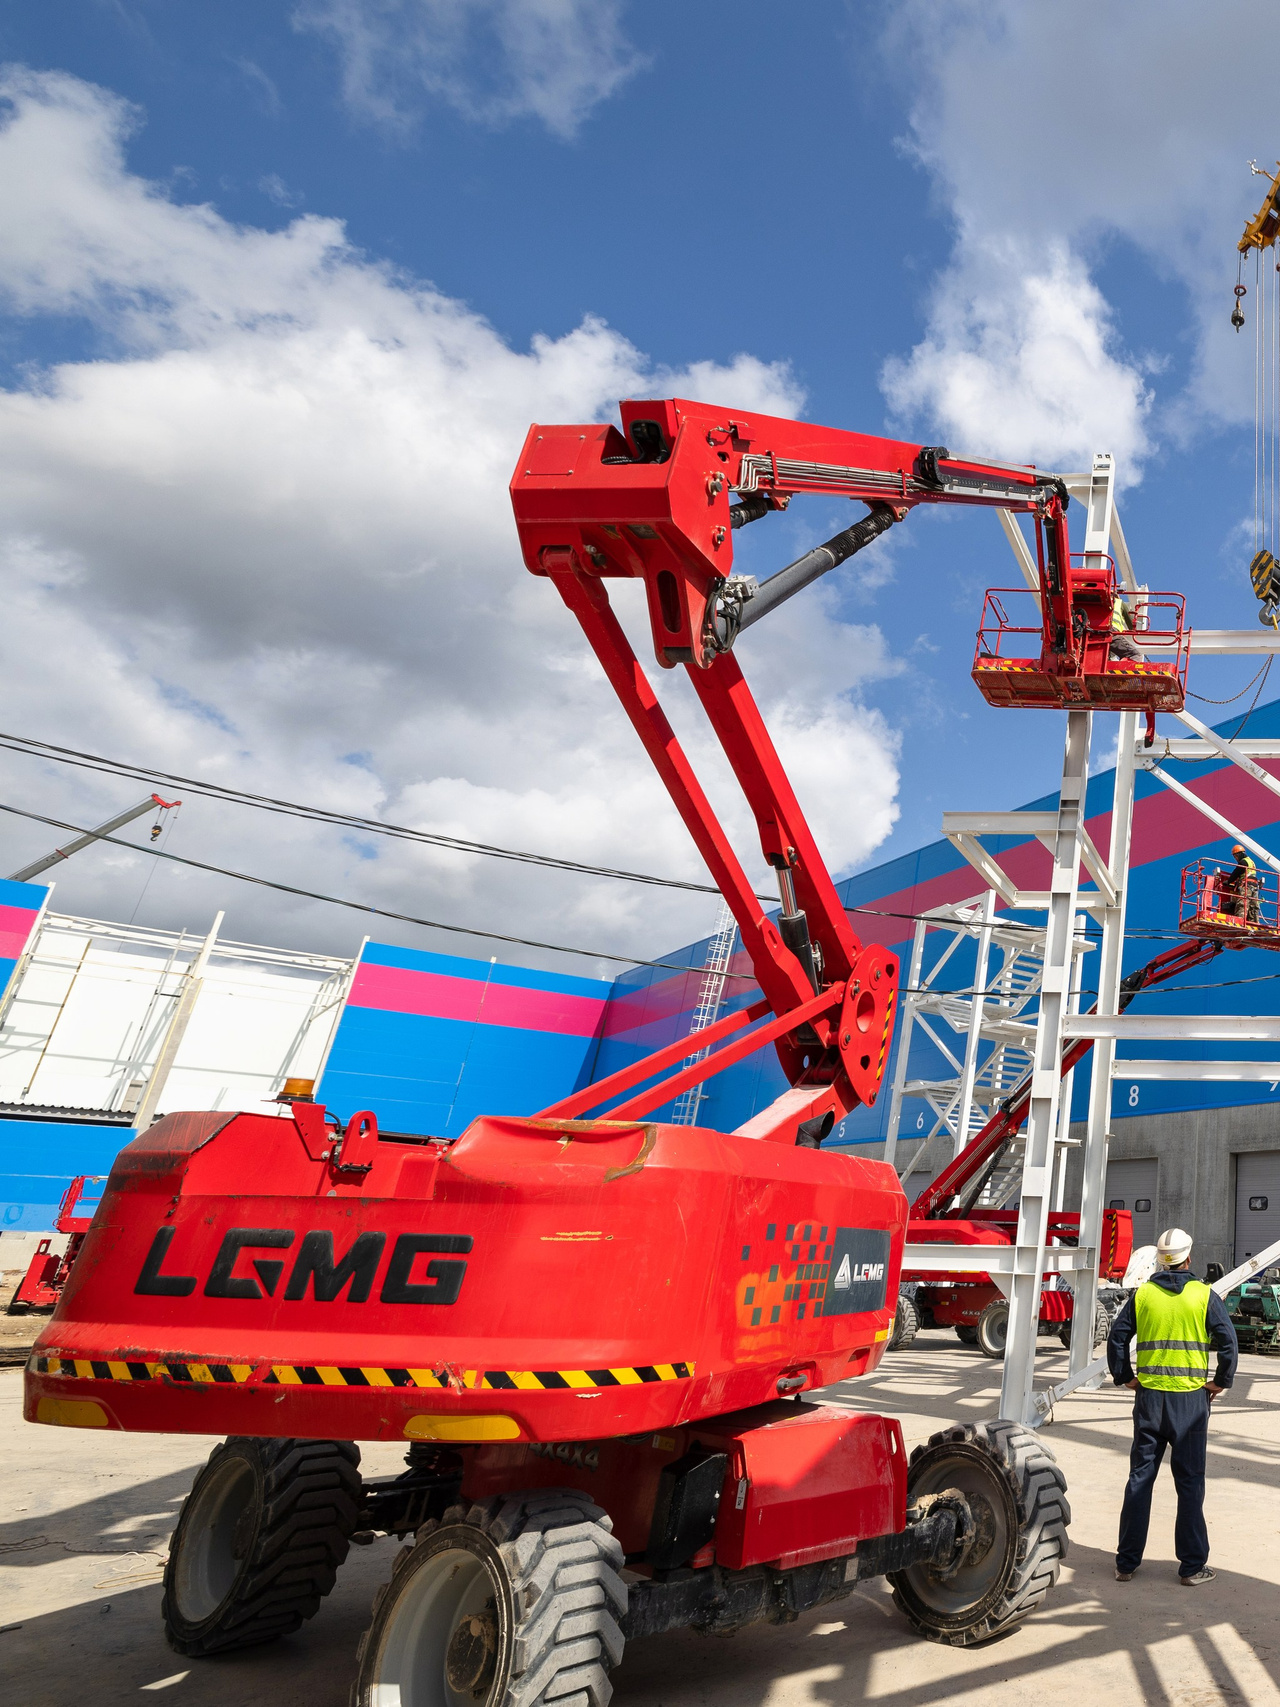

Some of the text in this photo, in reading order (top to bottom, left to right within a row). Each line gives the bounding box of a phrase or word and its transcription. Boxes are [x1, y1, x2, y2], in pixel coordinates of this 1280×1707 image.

[1129, 1085, 1139, 1107] 8
[838, 1122, 846, 1137] 5
[917, 1112, 924, 1129] 6
[134, 1226, 474, 1305] LGMG
[853, 1263, 884, 1282] LGMG
